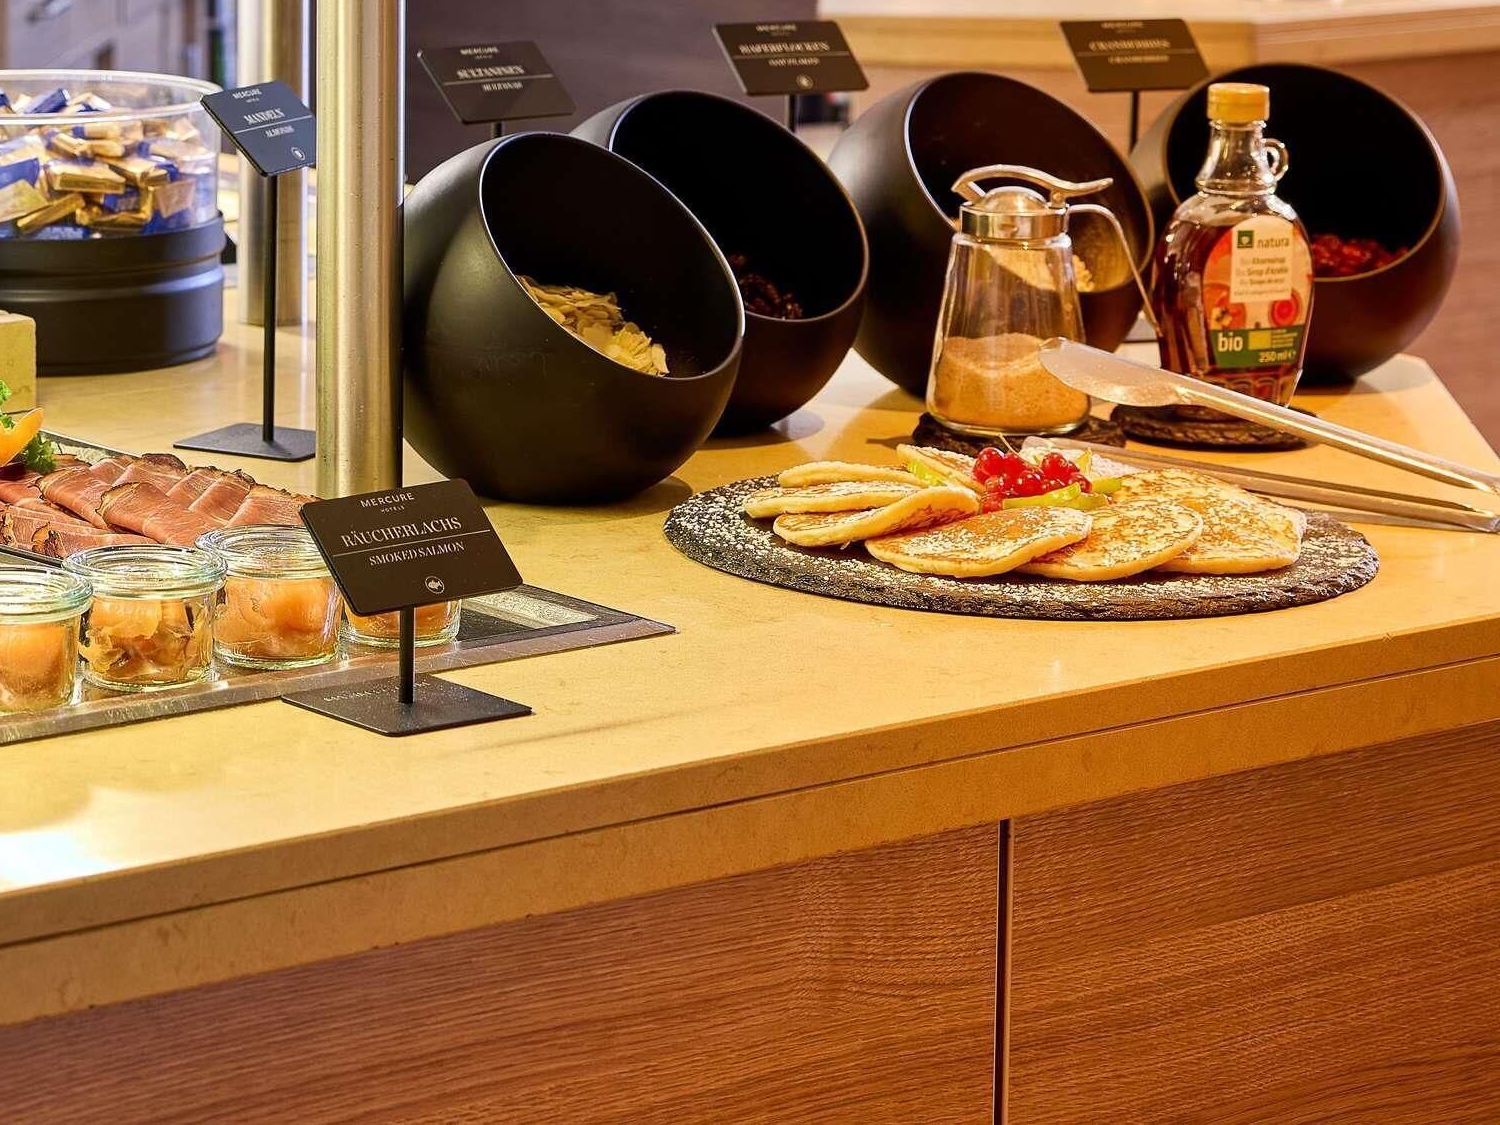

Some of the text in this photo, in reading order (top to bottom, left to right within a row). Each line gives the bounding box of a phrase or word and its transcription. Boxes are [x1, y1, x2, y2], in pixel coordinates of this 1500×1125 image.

[1256, 237, 1290, 249] natura
[1217, 331, 1243, 352] bio
[360, 492, 415, 508] MERCURE
[380, 505, 405, 513] HOTELS
[340, 516, 462, 548] RÄUCHERLACHS
[369, 540, 465, 566] SMOKED SALMON
